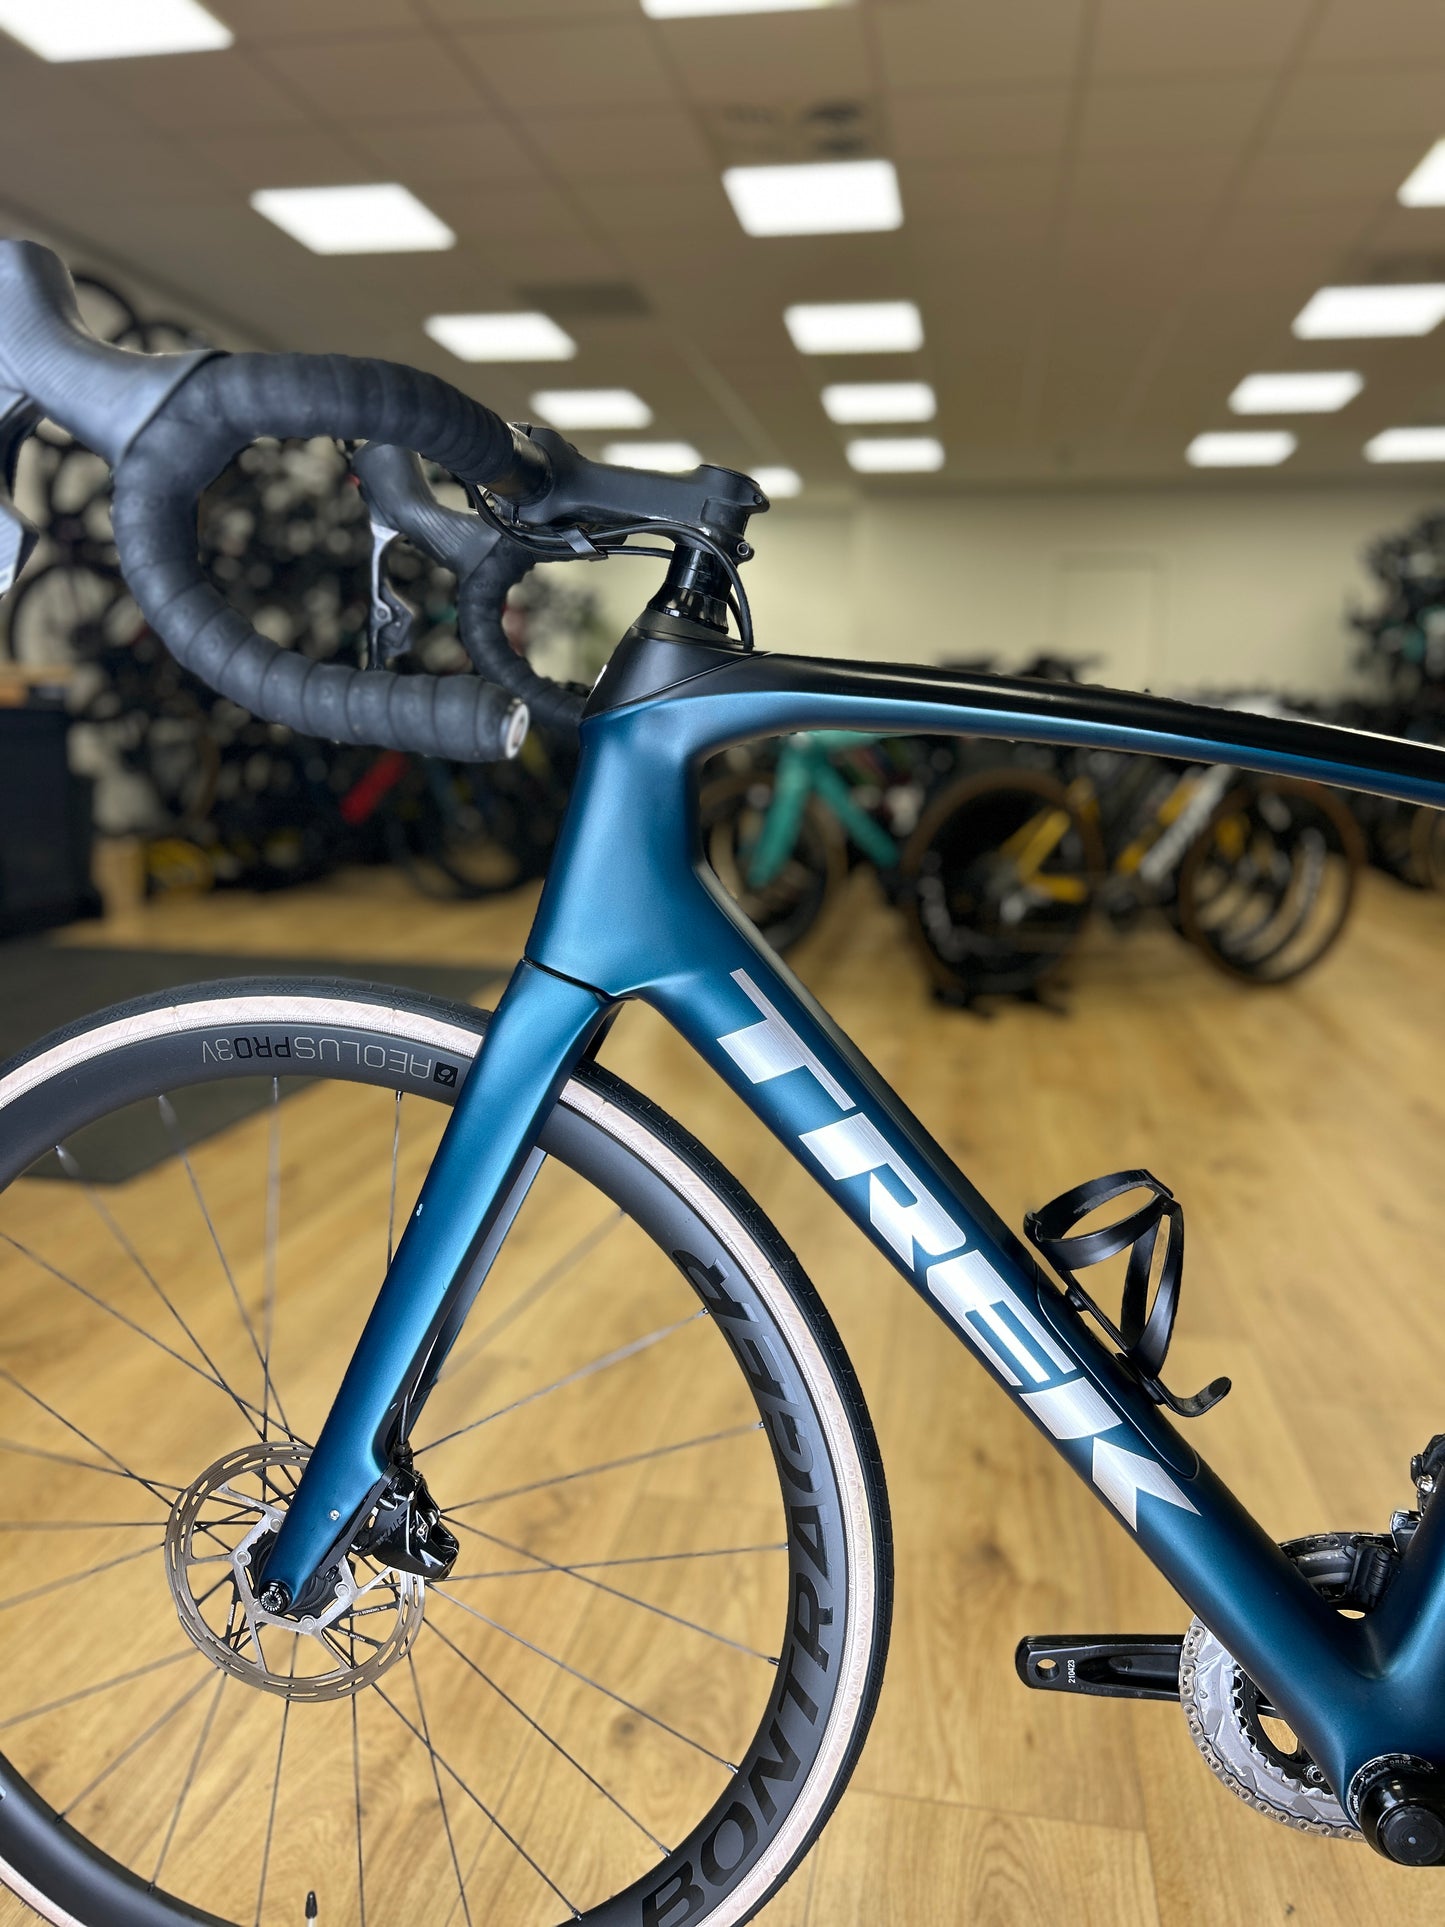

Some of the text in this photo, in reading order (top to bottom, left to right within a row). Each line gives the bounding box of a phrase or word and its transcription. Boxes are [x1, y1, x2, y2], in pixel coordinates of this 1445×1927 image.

[717, 968, 1201, 1532] TREK
[641, 1249, 833, 1927] BONTRAGER
[1067, 1660, 1075, 1683] 210423
